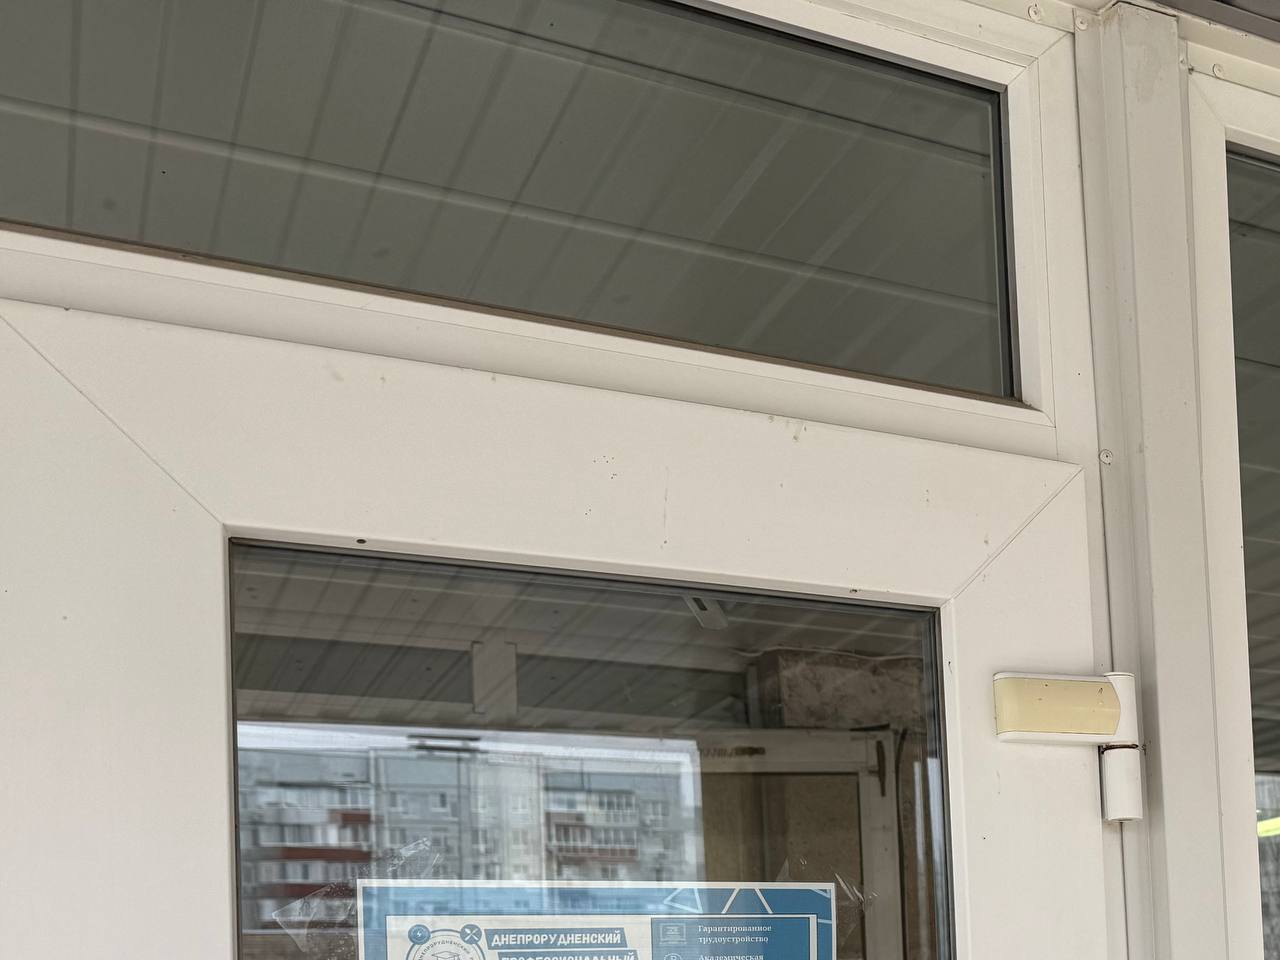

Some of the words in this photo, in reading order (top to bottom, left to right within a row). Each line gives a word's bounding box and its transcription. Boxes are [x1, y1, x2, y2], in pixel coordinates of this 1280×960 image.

[698, 925, 771, 933] Гарантированное
[492, 930, 621, 946] ДНЕПРОРУДНЕНСКИЙ
[699, 936, 768, 944] трудоустройство
